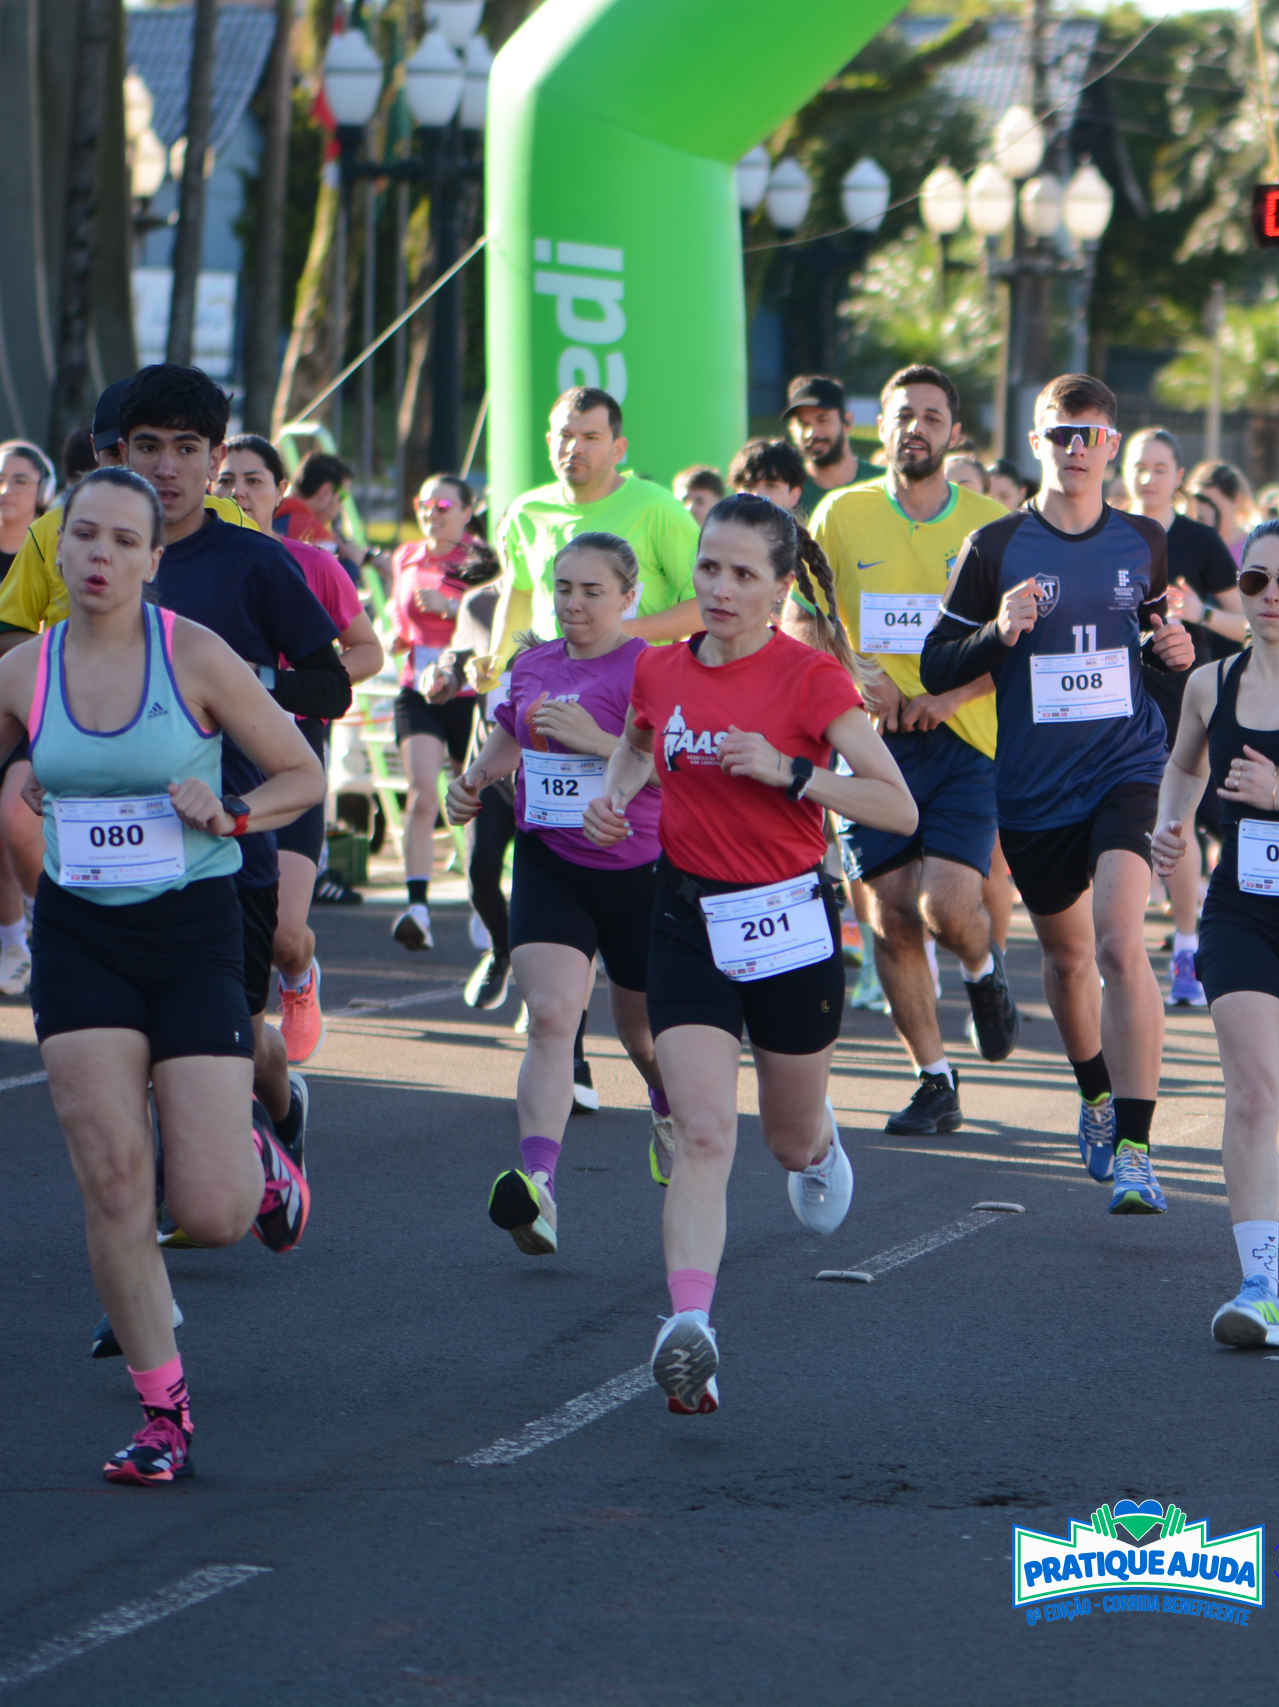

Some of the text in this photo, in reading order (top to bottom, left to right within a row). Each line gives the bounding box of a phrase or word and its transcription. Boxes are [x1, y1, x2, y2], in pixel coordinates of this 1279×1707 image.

[884, 612, 922, 627] 044
[1072, 624, 1097, 654] 11
[1061, 673, 1103, 692] 008
[541, 778, 579, 796] 182
[90, 824, 144, 848] 080
[741, 912, 790, 942] 201
